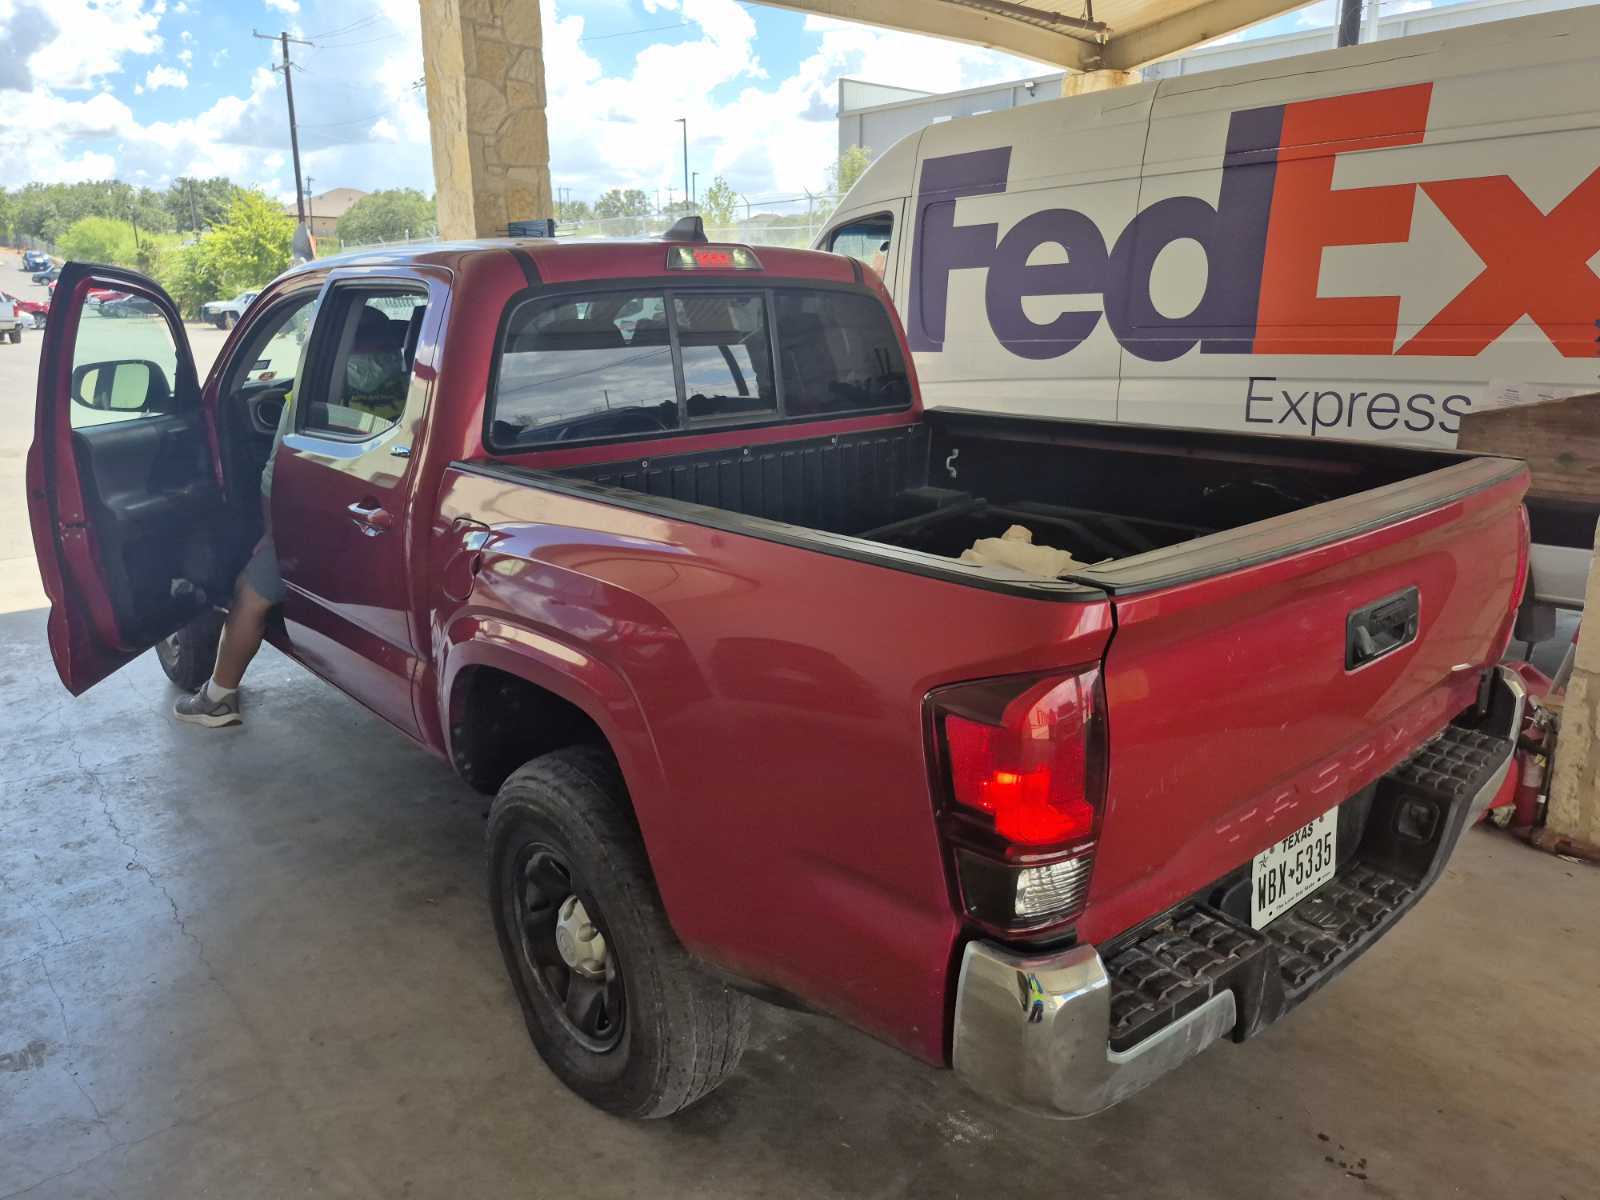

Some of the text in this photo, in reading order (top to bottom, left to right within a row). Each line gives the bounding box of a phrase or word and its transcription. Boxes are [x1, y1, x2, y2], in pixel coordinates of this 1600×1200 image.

[907, 82, 1600, 362] FedEx
[1245, 376, 1472, 436] Express
[1282, 823, 1314, 853] TEXAS
[1295, 831, 1332, 885] 5335
